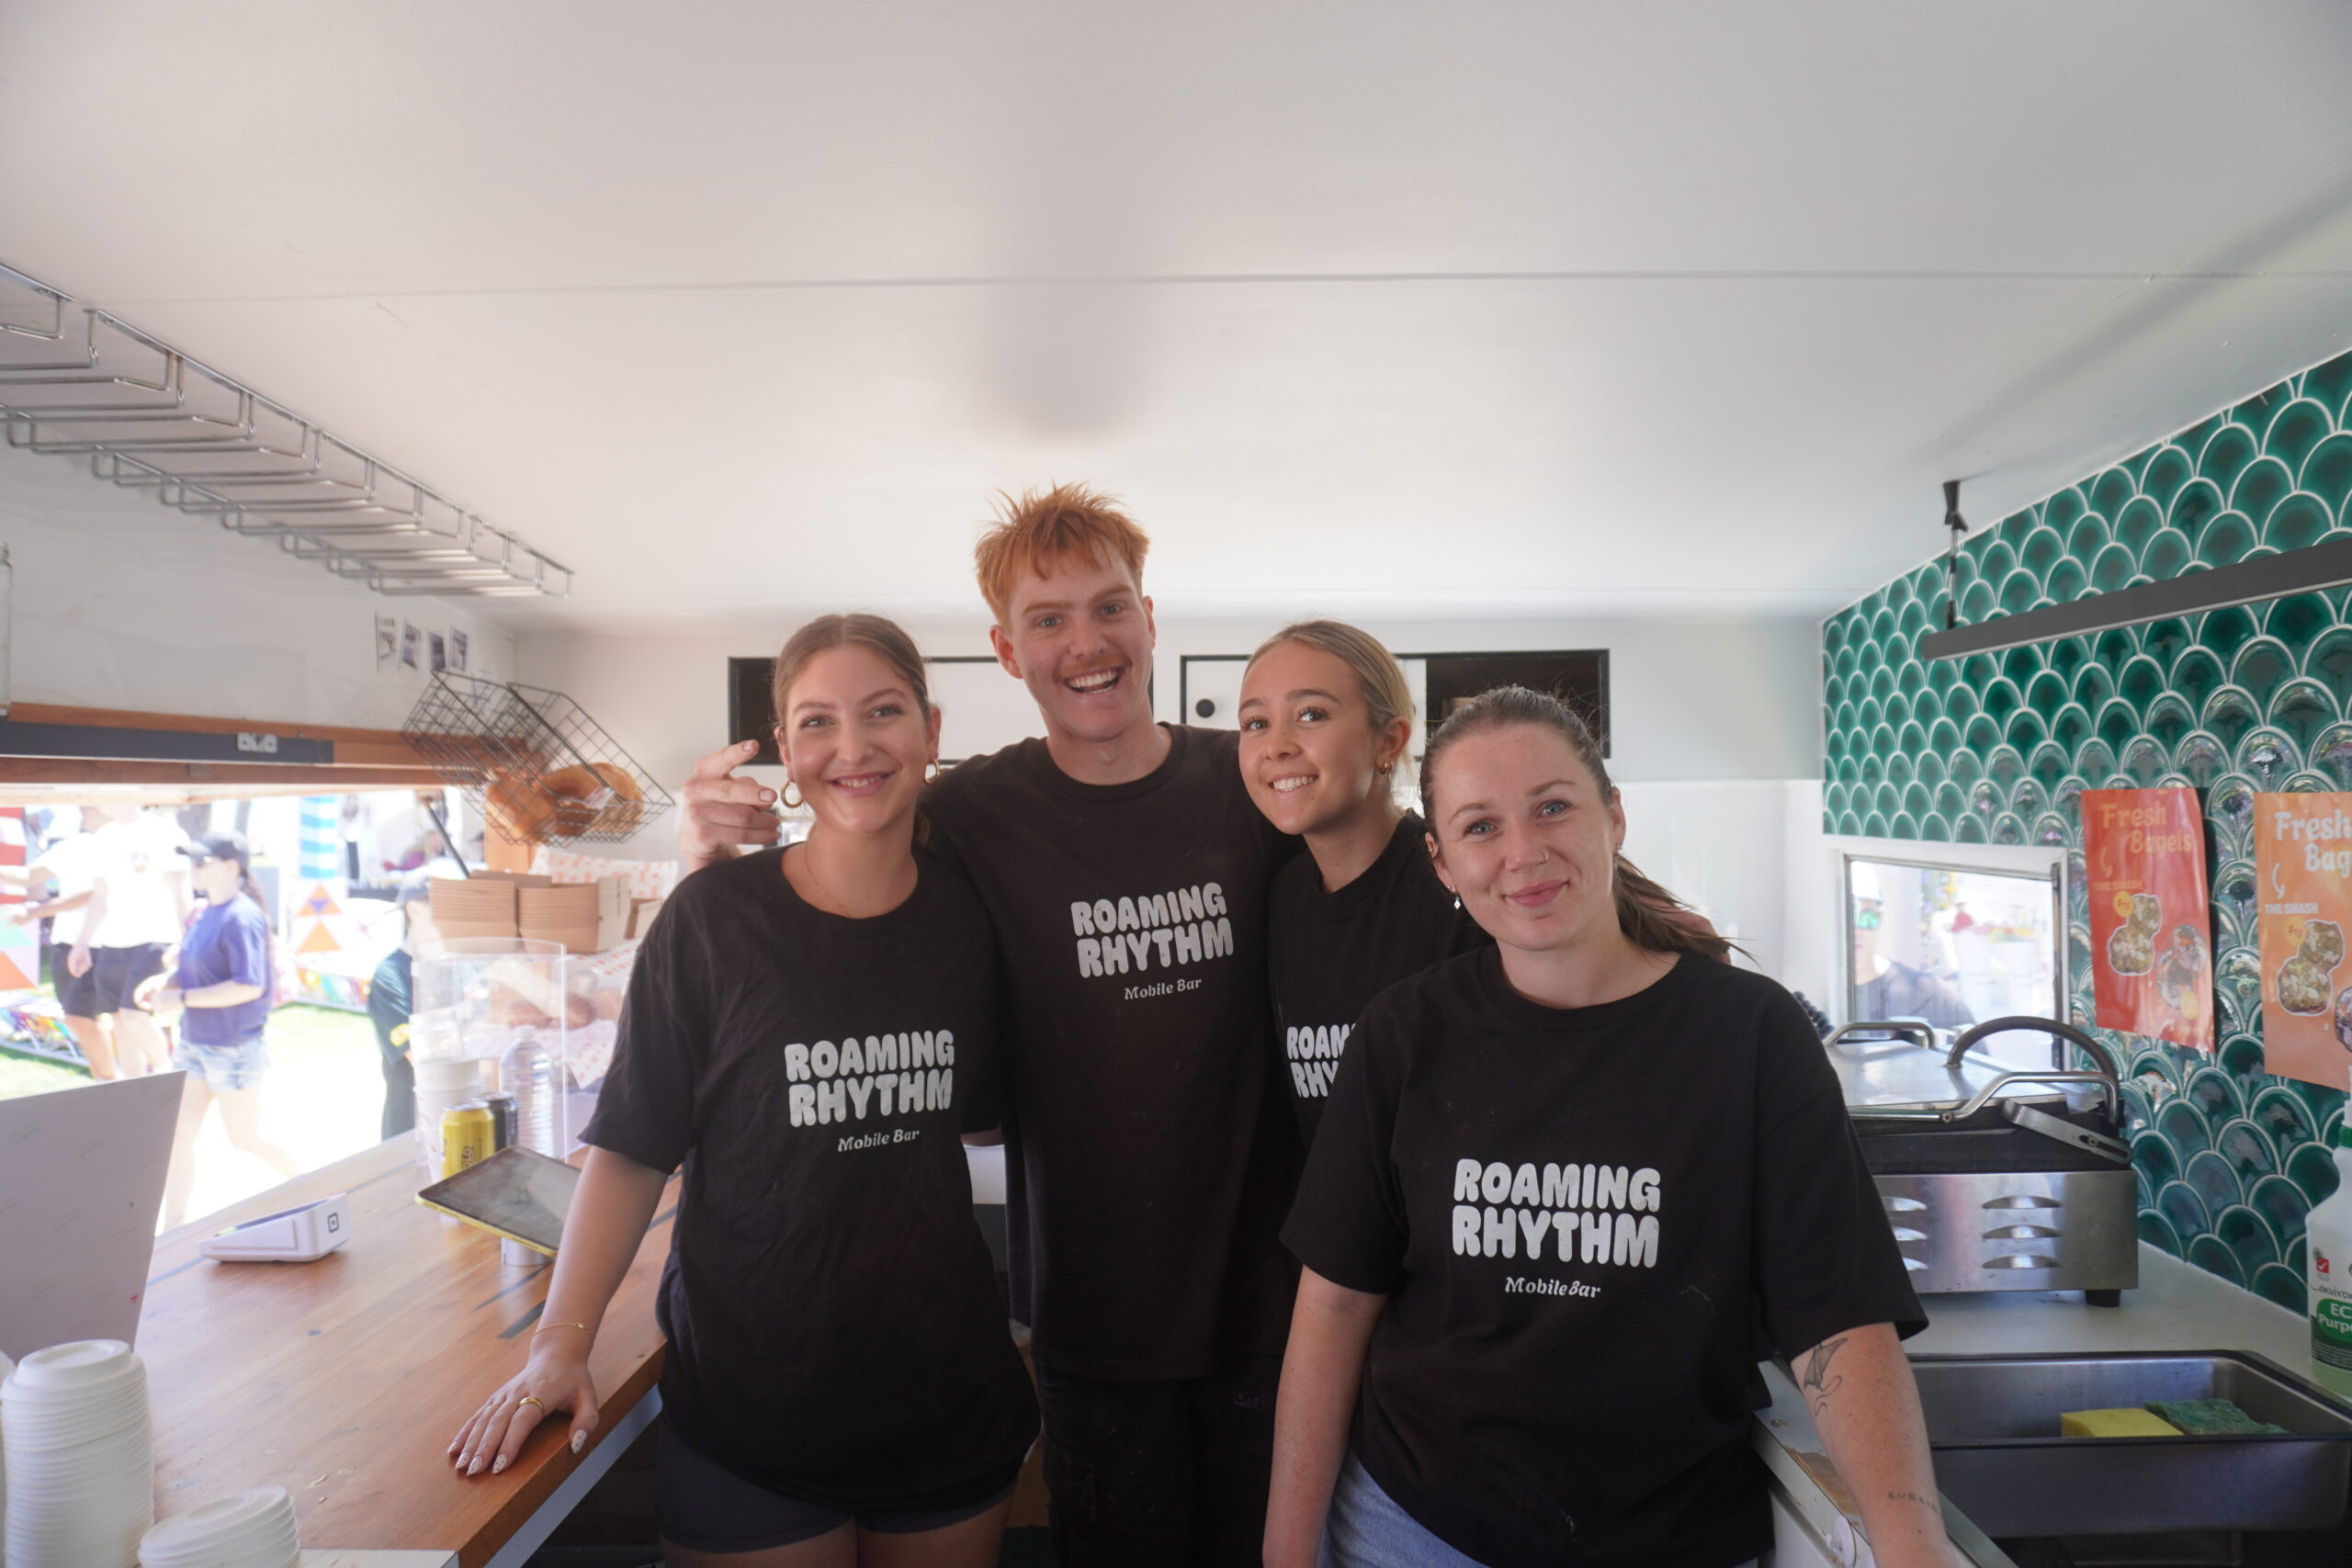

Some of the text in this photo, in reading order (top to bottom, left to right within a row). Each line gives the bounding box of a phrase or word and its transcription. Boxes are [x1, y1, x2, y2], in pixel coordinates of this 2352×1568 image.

[2101, 800, 2167, 829] Fresh
[2274, 808, 2352, 840] Fresh
[2131, 829, 2193, 859] Bagels
[2304, 843, 2352, 879] Bag
[1070, 882, 1227, 937] ROAMING
[2264, 902, 2319, 915] THE SMASH
[1076, 917, 1234, 978] RHYTHM
[1124, 978, 1202, 1000] Mobile Bar
[784, 1029, 955, 1083] ROAMING
[1286, 1022, 1356, 1060] ROAM
[788, 1067, 954, 1128] RHYTHM
[1290, 1060, 1340, 1099] RHY
[837, 1128, 920, 1153] Mobile Bar
[1453, 1158, 1661, 1213] ROAMING
[1452, 1204, 1660, 1269] RHYTHM
[2318, 1313, 2352, 1334] Purp
[2330, 1303, 2352, 1320] EC
